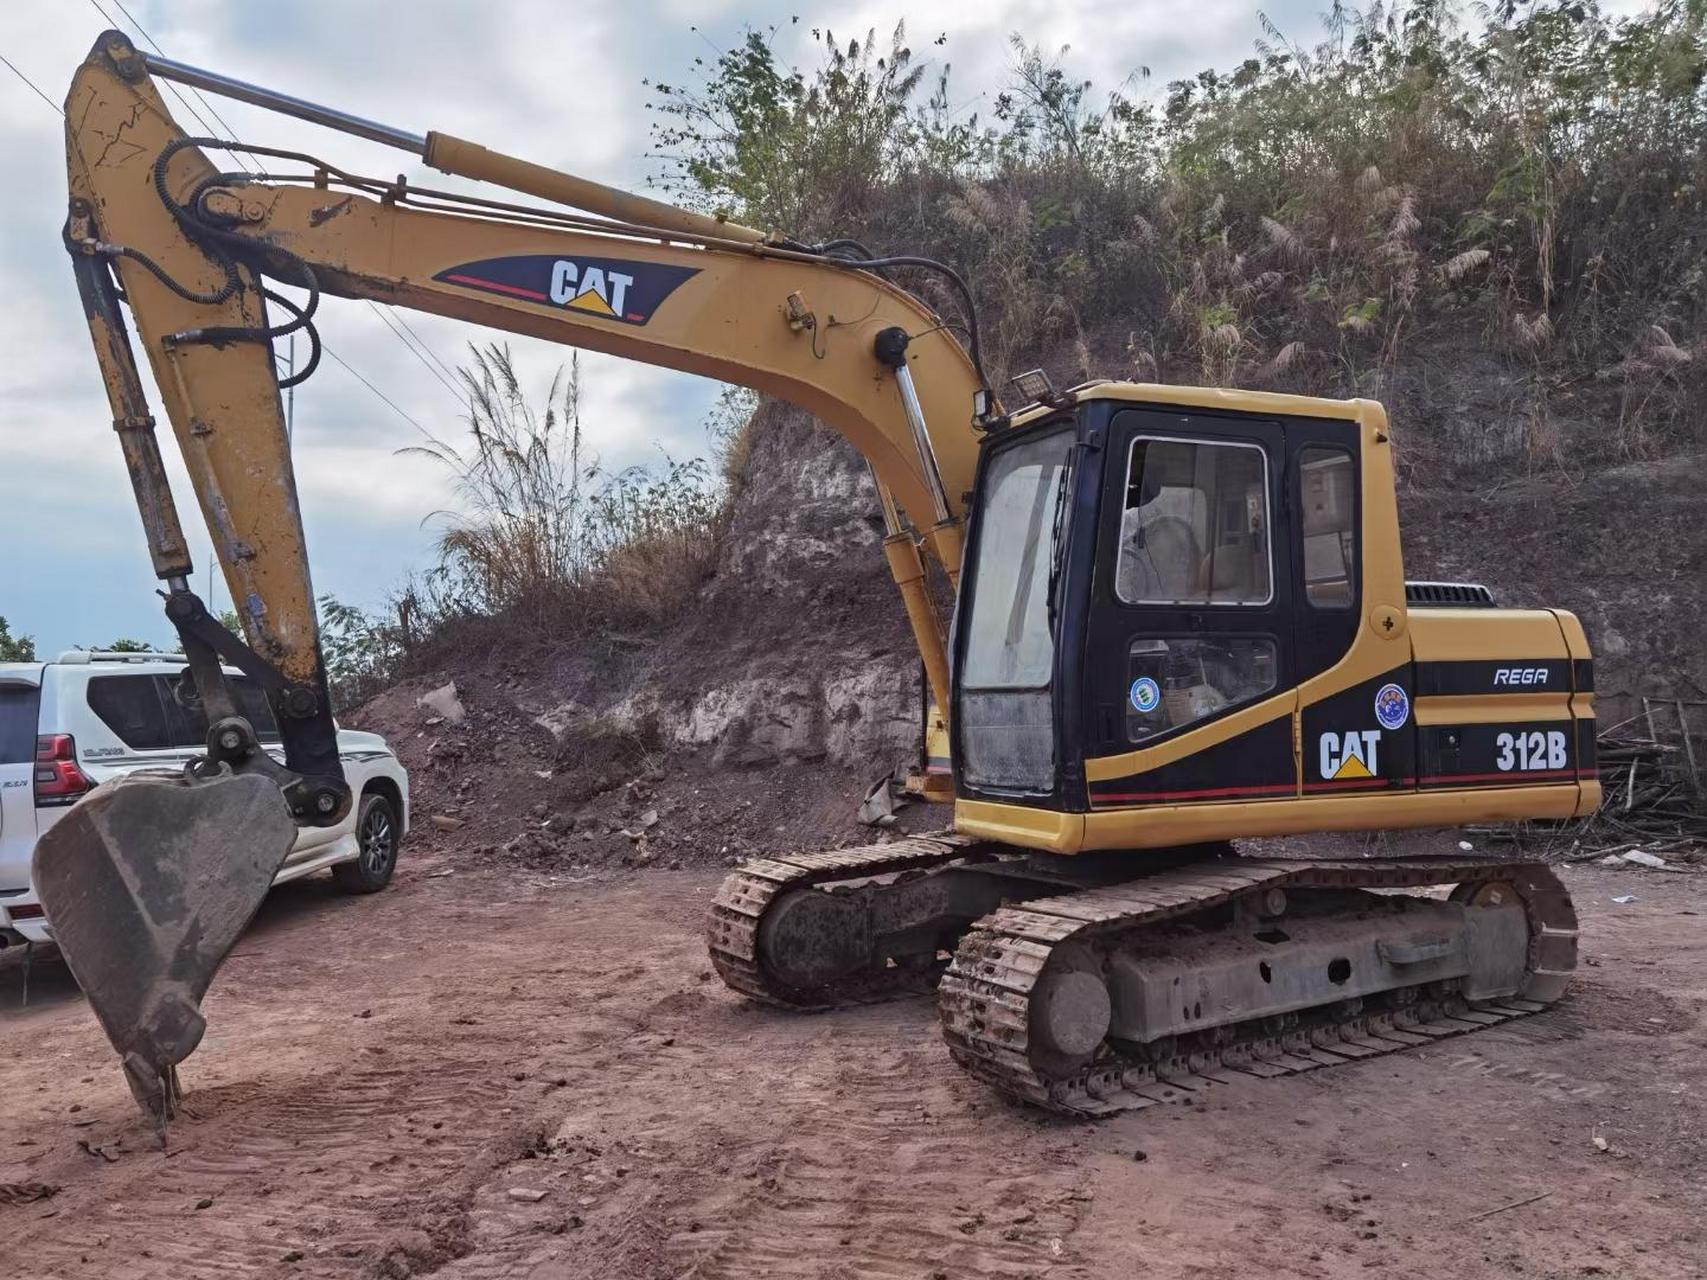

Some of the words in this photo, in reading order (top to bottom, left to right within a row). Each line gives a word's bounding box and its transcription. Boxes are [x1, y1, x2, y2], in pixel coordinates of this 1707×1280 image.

[550, 260, 633, 317] CAT
[1493, 668, 1548, 685] REGA
[1320, 730, 1381, 779] CAT
[1496, 731, 1567, 772] 312B
